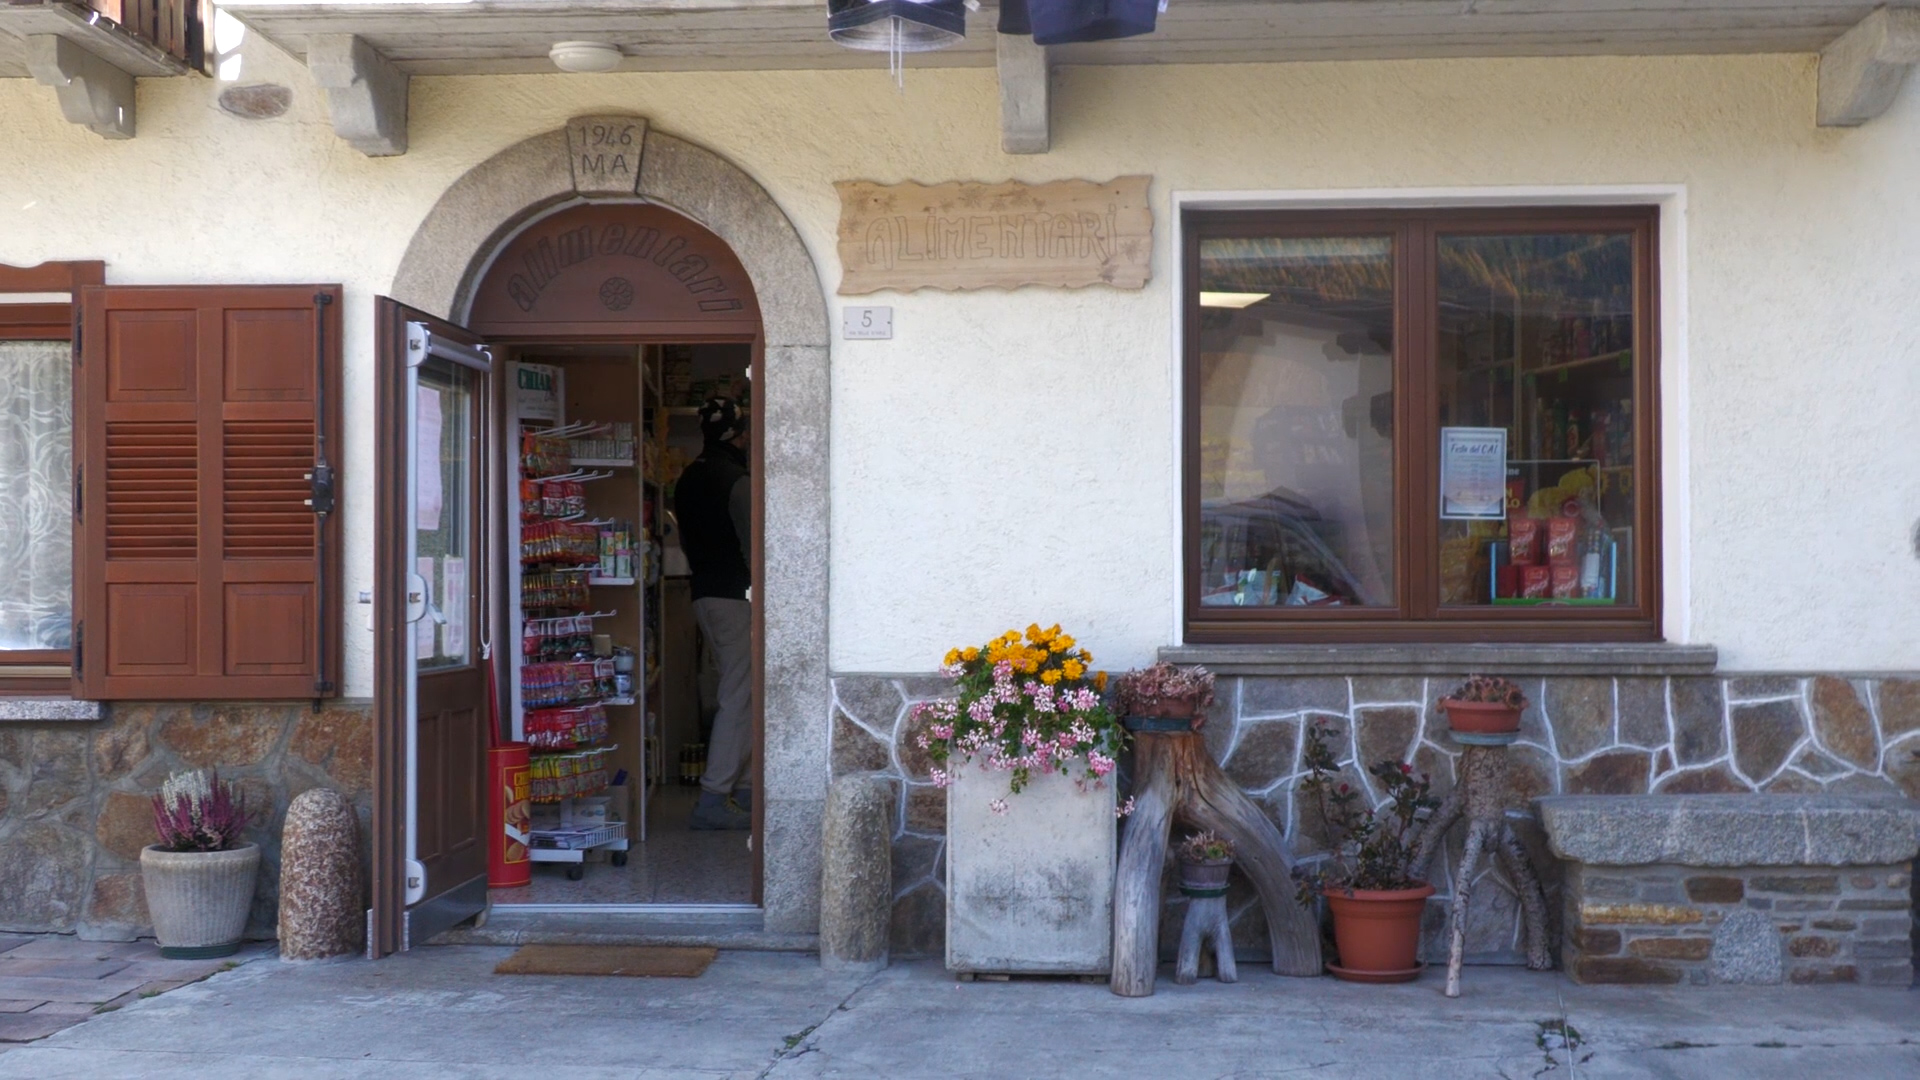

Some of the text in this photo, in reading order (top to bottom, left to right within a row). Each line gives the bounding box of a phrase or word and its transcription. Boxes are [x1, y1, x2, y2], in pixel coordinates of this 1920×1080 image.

[579, 125, 636, 148] 1946
[861, 310, 873, 328] 5
[1450, 443, 1499, 454] Festa del CAI
